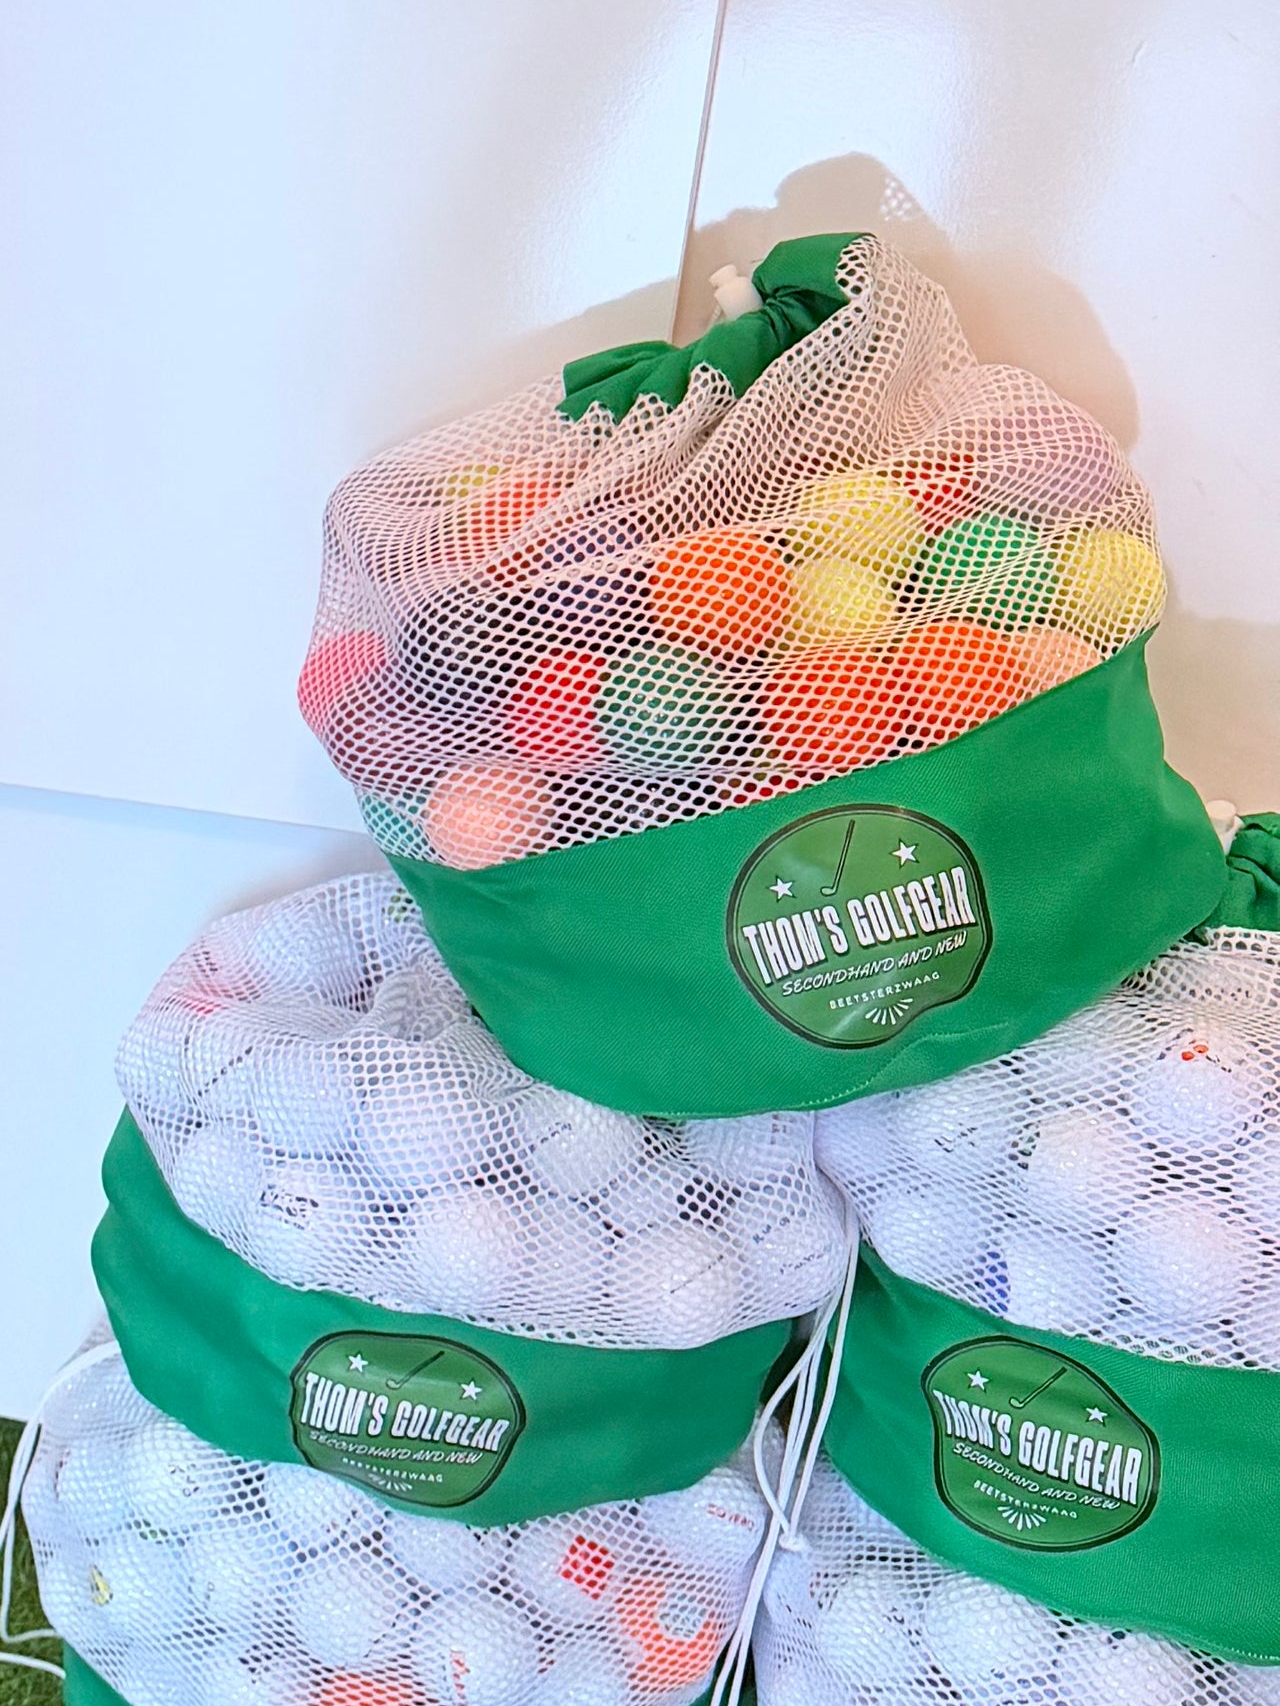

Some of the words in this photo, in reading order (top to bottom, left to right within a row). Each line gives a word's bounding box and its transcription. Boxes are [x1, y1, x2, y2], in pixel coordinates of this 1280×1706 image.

[742, 904, 849, 985] THOM'S
[846, 866, 977, 948] GOLFGEAR
[782, 958, 894, 996] SECONDHAND
[898, 946, 933, 969] AND
[935, 930, 967, 957] NEW
[300, 1372, 390, 1437] THOM'S
[391, 1400, 510, 1453] GOLFGEAR
[932, 1388, 1013, 1457] THOM'S
[1017, 1420, 1143, 1505] GOLFGEAR
[413, 1449, 444, 1463] AND
[953, 1442, 1040, 1493] SECONDHAND
[1041, 1486, 1079, 1502] AND
[1079, 1495, 1122, 1511] NEW
